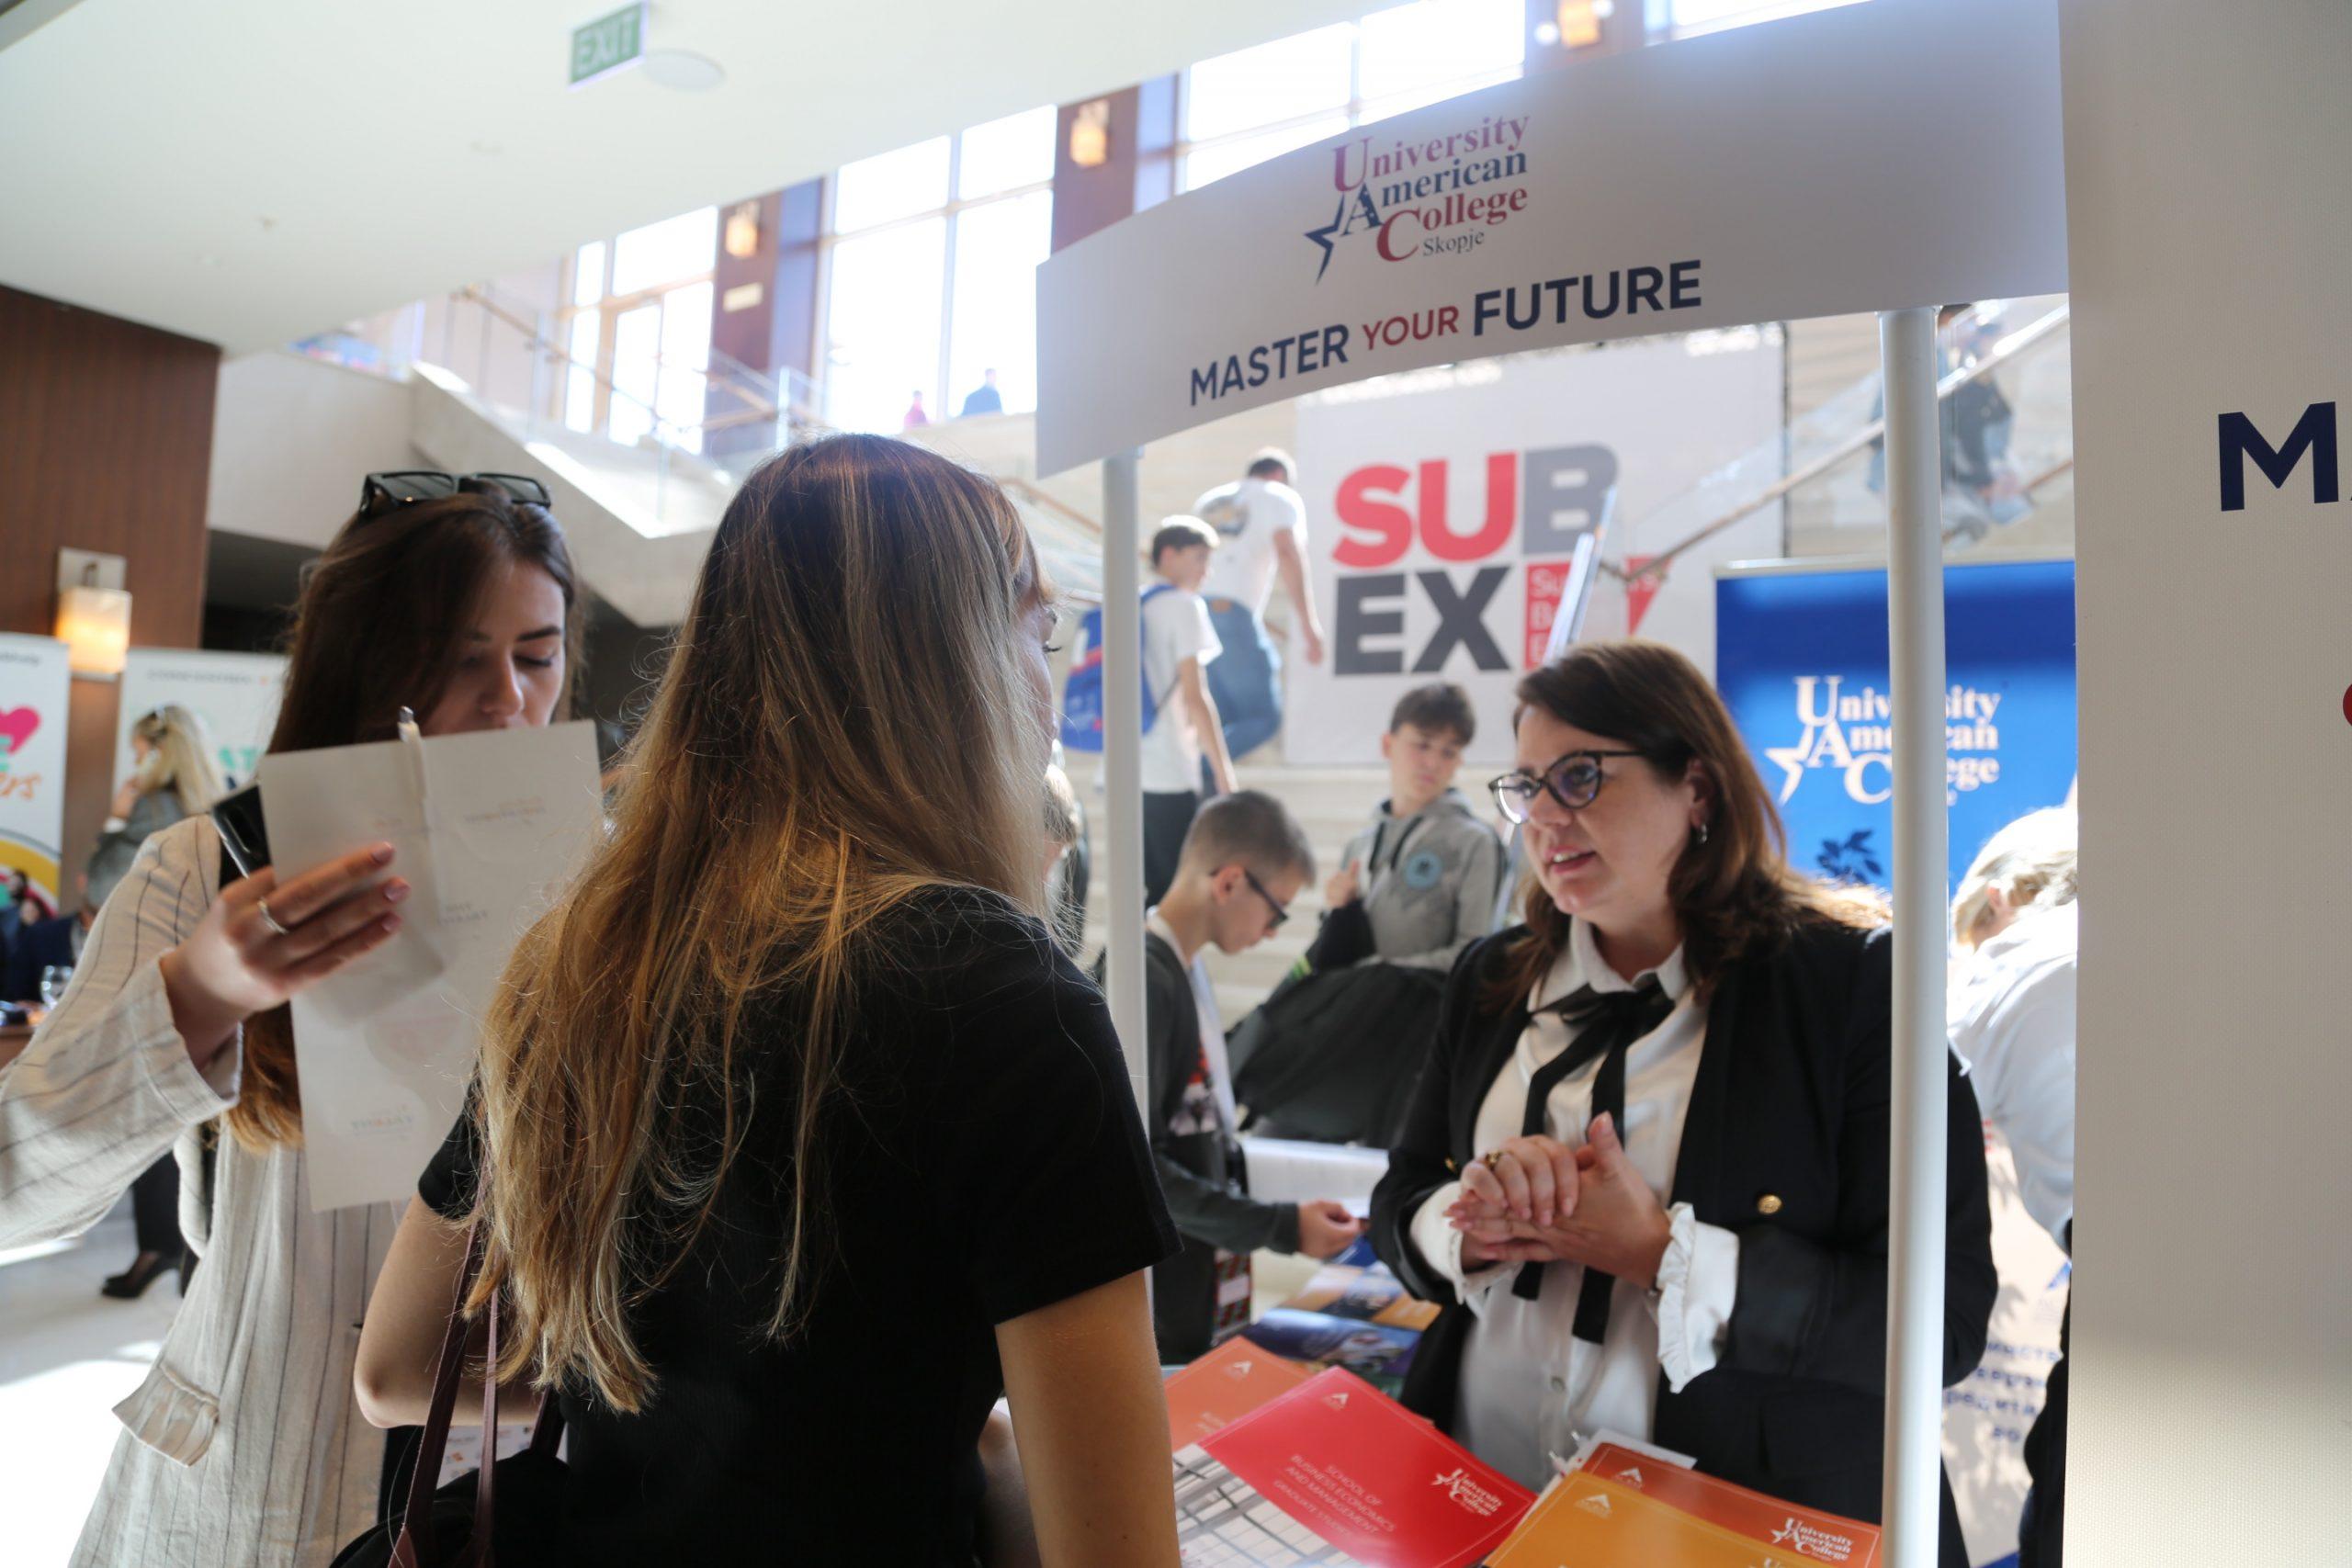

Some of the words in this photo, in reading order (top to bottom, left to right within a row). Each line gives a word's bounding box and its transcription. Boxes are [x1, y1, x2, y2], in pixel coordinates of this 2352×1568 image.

[577, 13, 636, 73] EXIT
[1333, 116, 1531, 192] University
[1340, 151, 1528, 237] American
[1375, 187, 1528, 262] College
[1422, 229, 1485, 257] Skopje
[1191, 323, 1349, 406] MASTER
[1362, 305, 1459, 350] YOUR
[1474, 259, 1702, 336] FUTURE
[2218, 401, 2352, 512] M
[1331, 443, 1618, 569] SUB
[1334, 565, 1511, 676] EX
[1794, 675, 2001, 727] Univity
[1785, 1517, 1854, 1547] University
